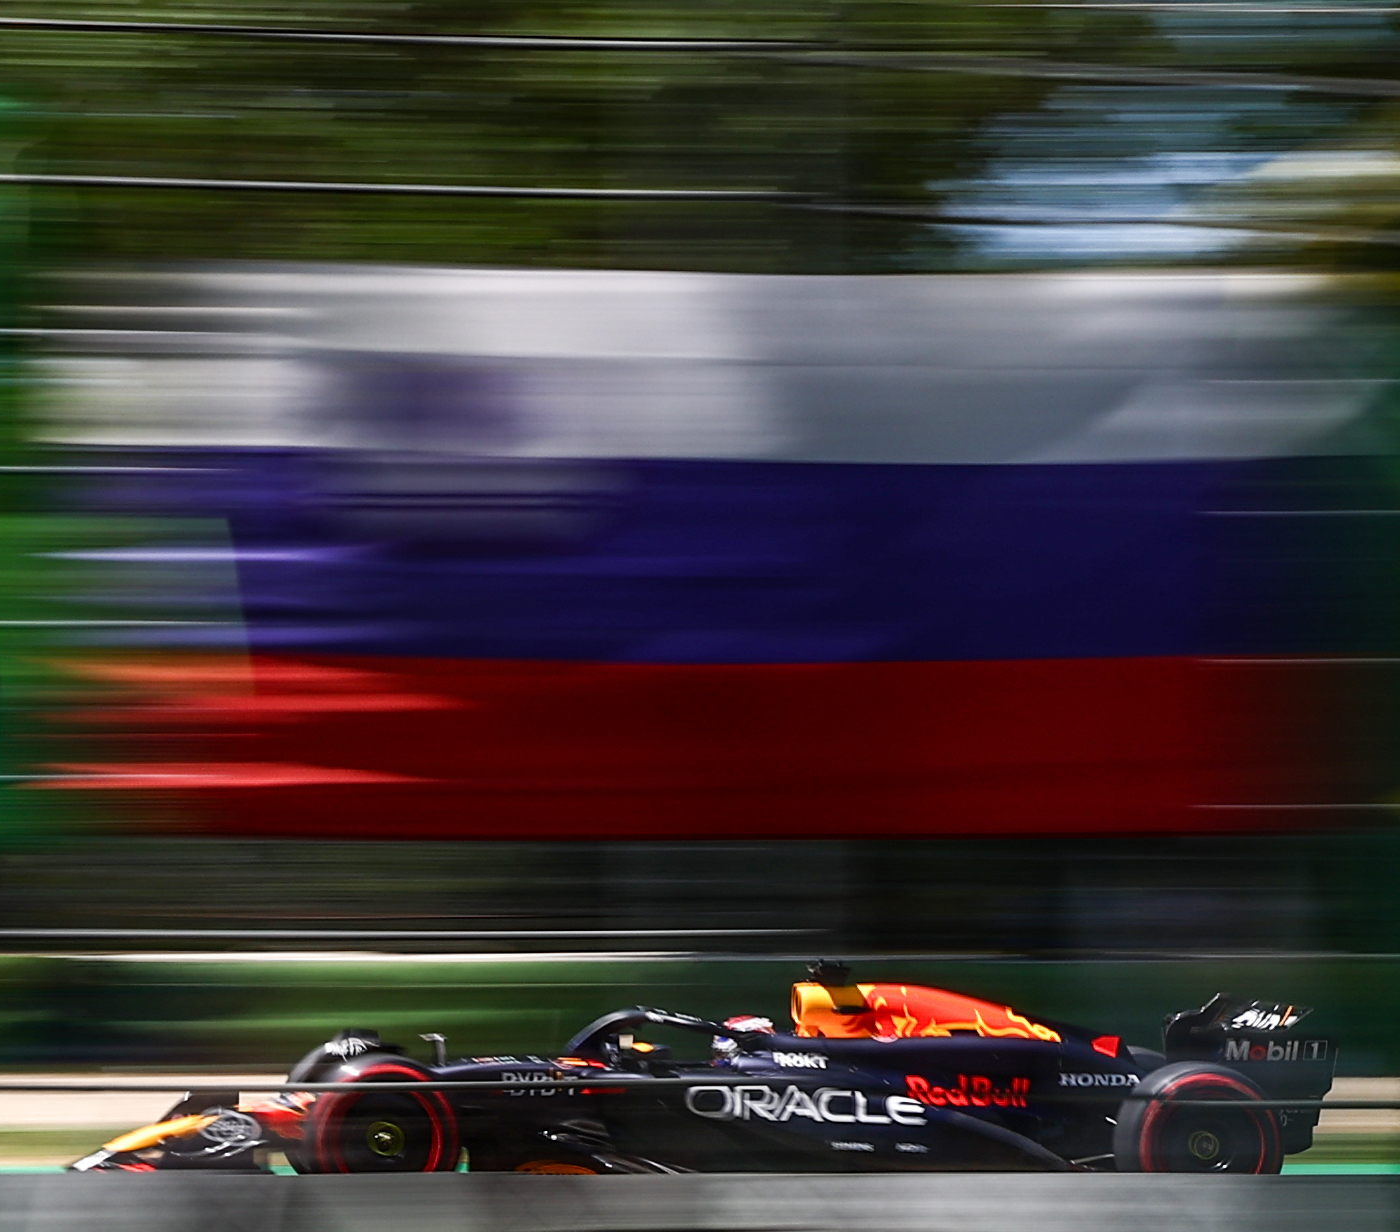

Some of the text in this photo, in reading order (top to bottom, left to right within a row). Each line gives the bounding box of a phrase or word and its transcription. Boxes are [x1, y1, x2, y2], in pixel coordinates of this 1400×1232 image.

[1225, 1039, 1299, 1061] Mobil
[905, 1074, 1030, 1107] Red Bull
[1059, 1072, 1140, 1087] HONDA
[685, 1085, 928, 1126] ORACLE
